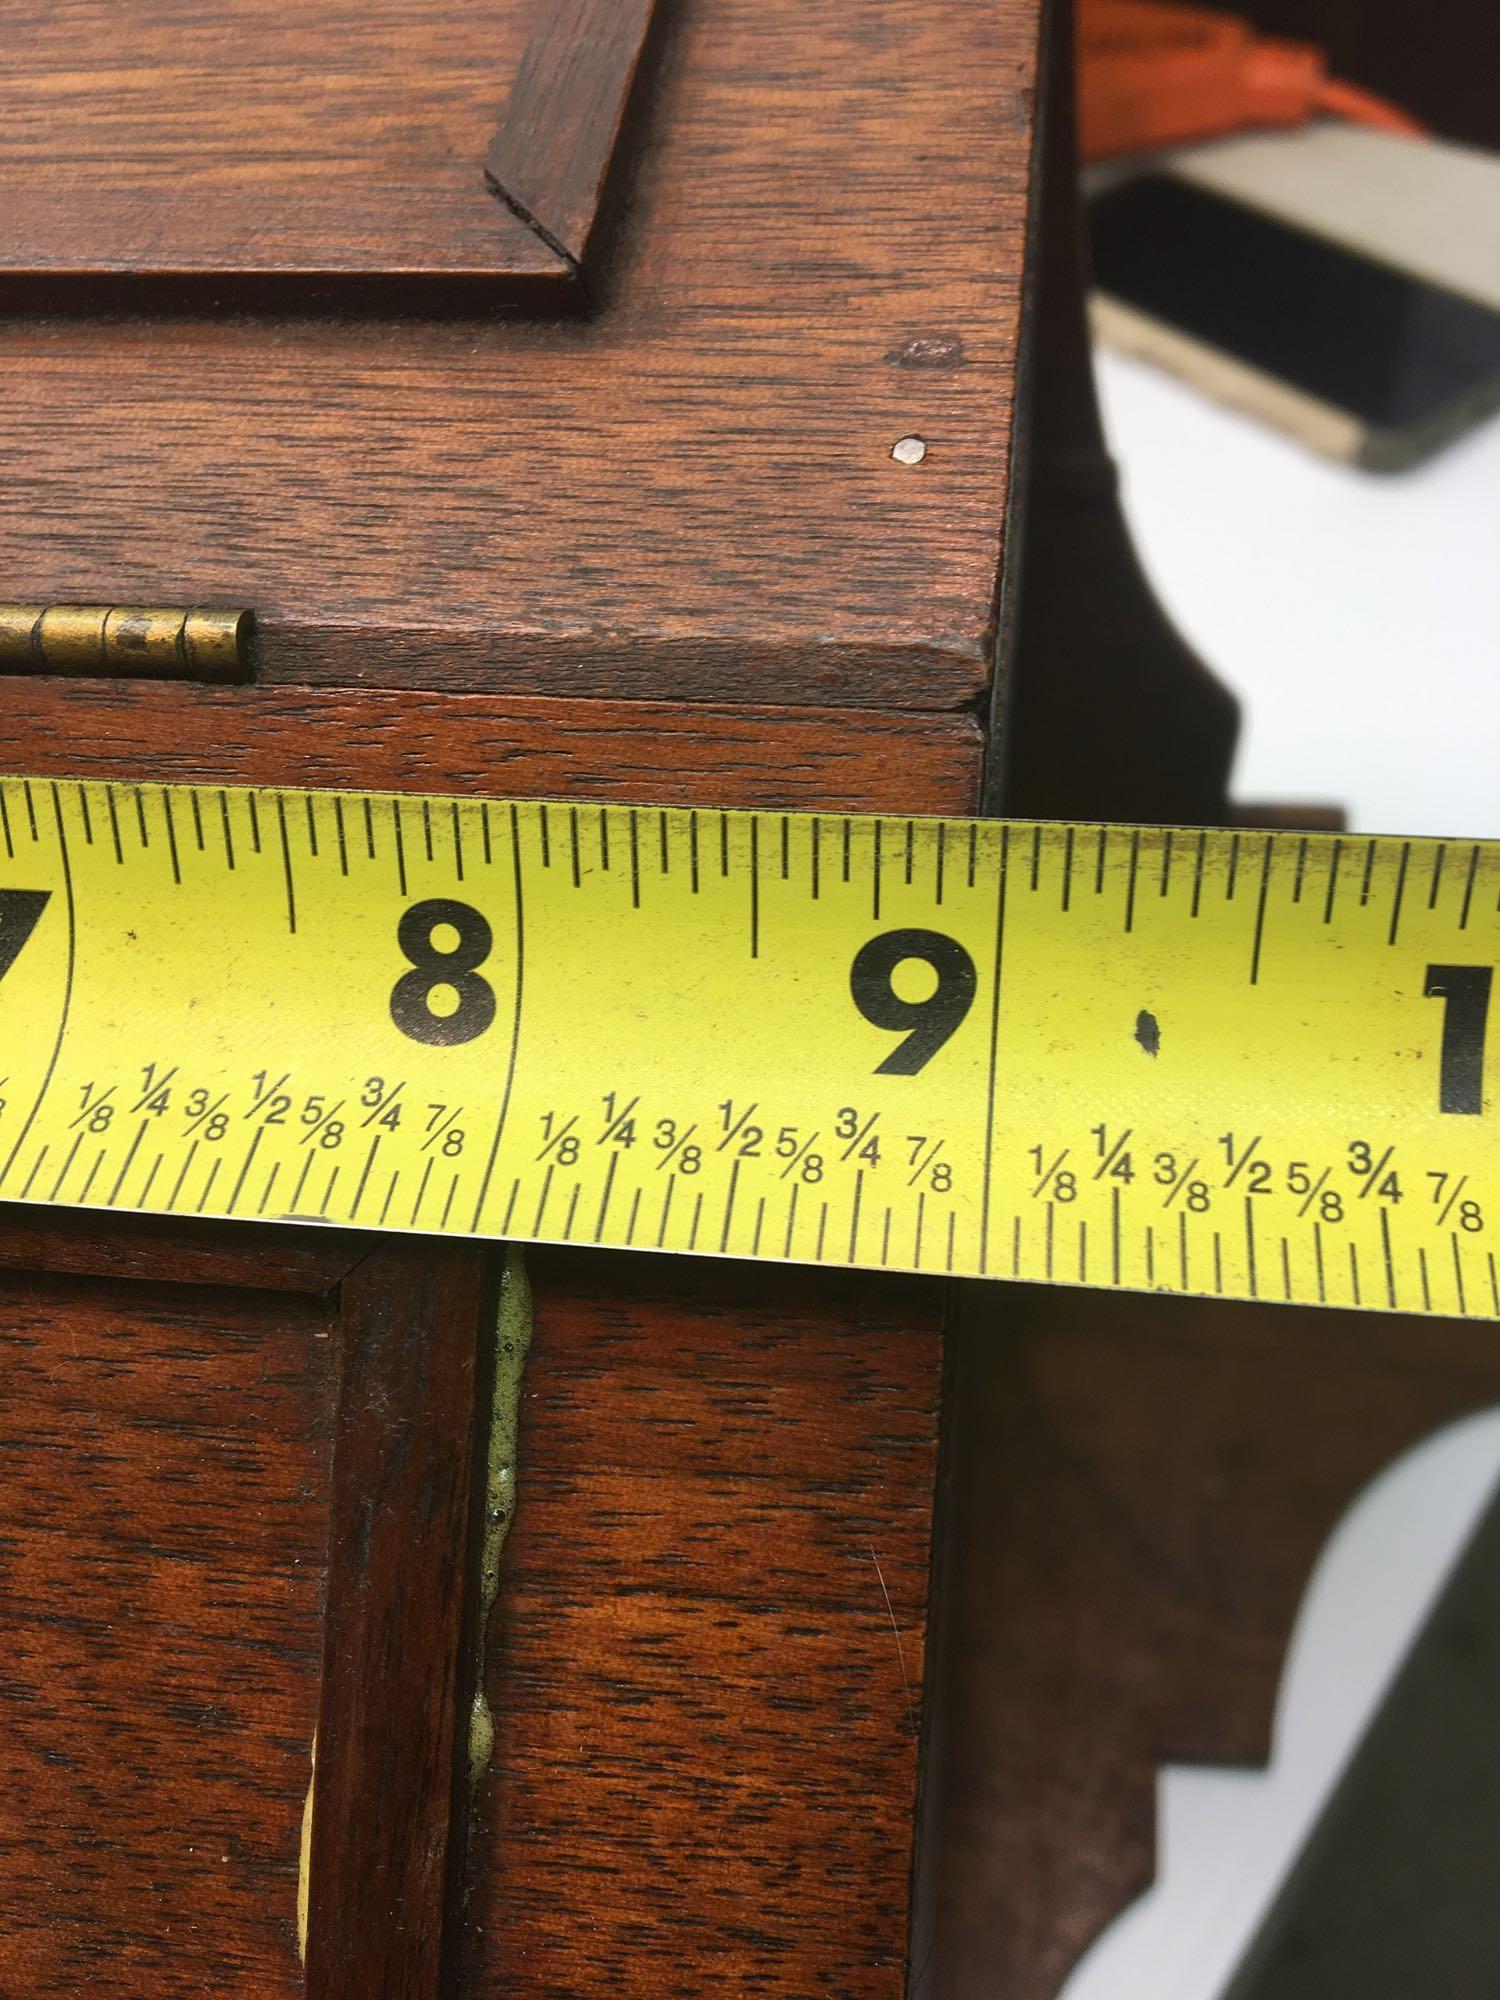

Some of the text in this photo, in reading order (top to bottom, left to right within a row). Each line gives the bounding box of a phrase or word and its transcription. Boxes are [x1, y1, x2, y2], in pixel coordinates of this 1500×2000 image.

[389, 898, 497, 1046] 8
[850, 928, 978, 1075] 9
[68, 1080, 117, 1134] 1/8
[129, 1062, 179, 1116] 1/4
[182, 1088, 230, 1141] 3/8
[243, 1069, 292, 1125] 1/2
[299, 1095, 345, 1150] 5/8
[359, 1076, 406, 1132] 3/4
[420, 1104, 464, 1157] 7/8
[536, 1111, 579, 1167] 1/8
[596, 1091, 640, 1148] 1/4
[654, 1119, 701, 1175] 3/8
[716, 1099, 763, 1158] 1/2
[775, 1128, 824, 1183] 5/8
[835, 1107, 881, 1168] 3/4
[907, 1136, 952, 1193] 7/8
[1029, 1144, 1077, 1203] 1/8
[1091, 1123, 1135, 1184] 1/4
[1154, 1153, 1211, 1213] 3/8
[1219, 1133, 1272, 1194] 1/2
[1287, 1163, 1344, 1223] 5/8
[1347, 1141, 1404, 1204] 3/4
[1426, 1172, 1483, 1233] 7/8
